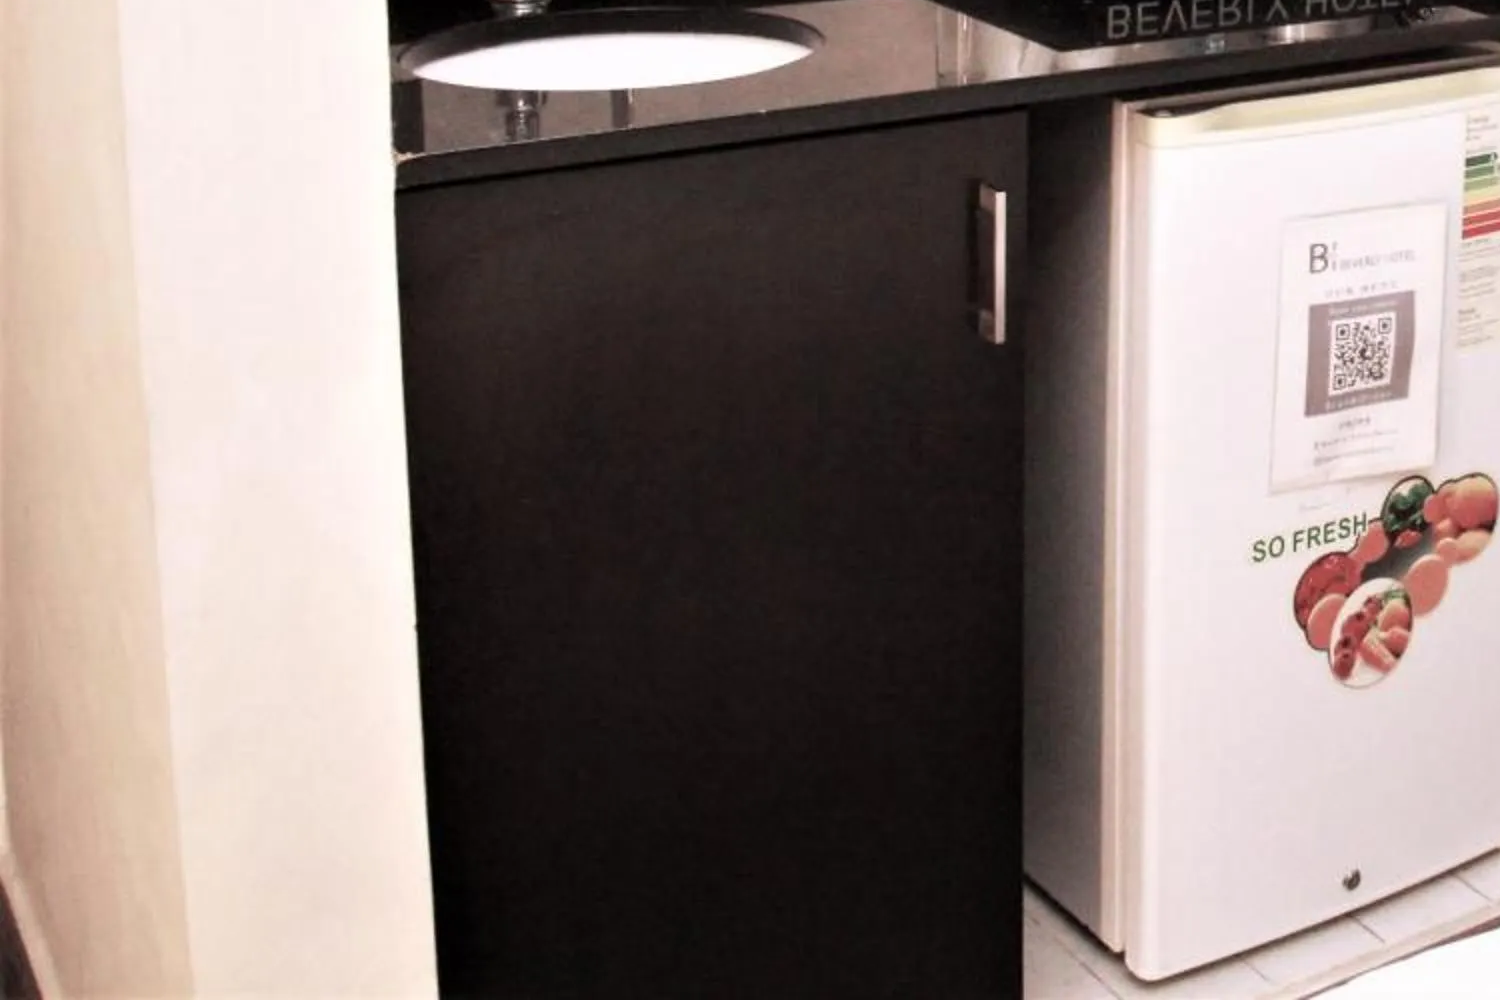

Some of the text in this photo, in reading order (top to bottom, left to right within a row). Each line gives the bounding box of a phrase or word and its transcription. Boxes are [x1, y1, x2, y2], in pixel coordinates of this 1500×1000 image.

[1309, 243, 1329, 274] B
[1250, 511, 1369, 564] SO FRESH
